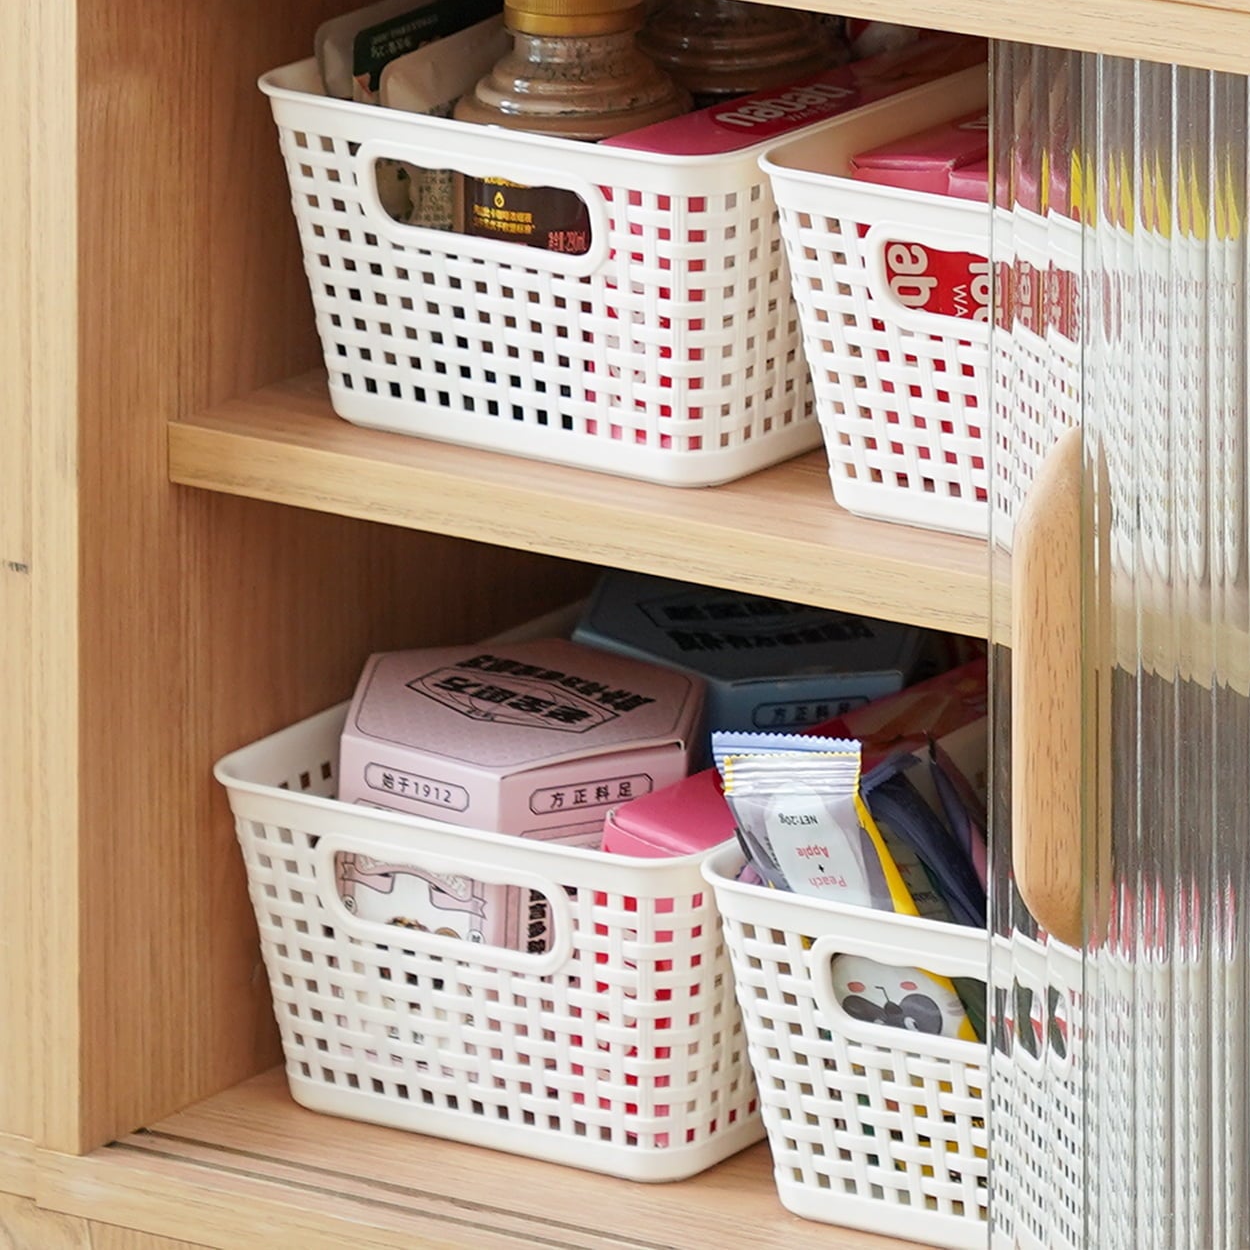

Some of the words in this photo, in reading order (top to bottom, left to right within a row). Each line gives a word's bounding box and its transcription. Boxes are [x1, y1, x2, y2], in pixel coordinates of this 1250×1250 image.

[381, 772, 451, 803] 始于1912
[551, 781, 633, 809] 方正料足
[797, 844, 830, 859] Apple
[810, 876, 847, 889] Peach
